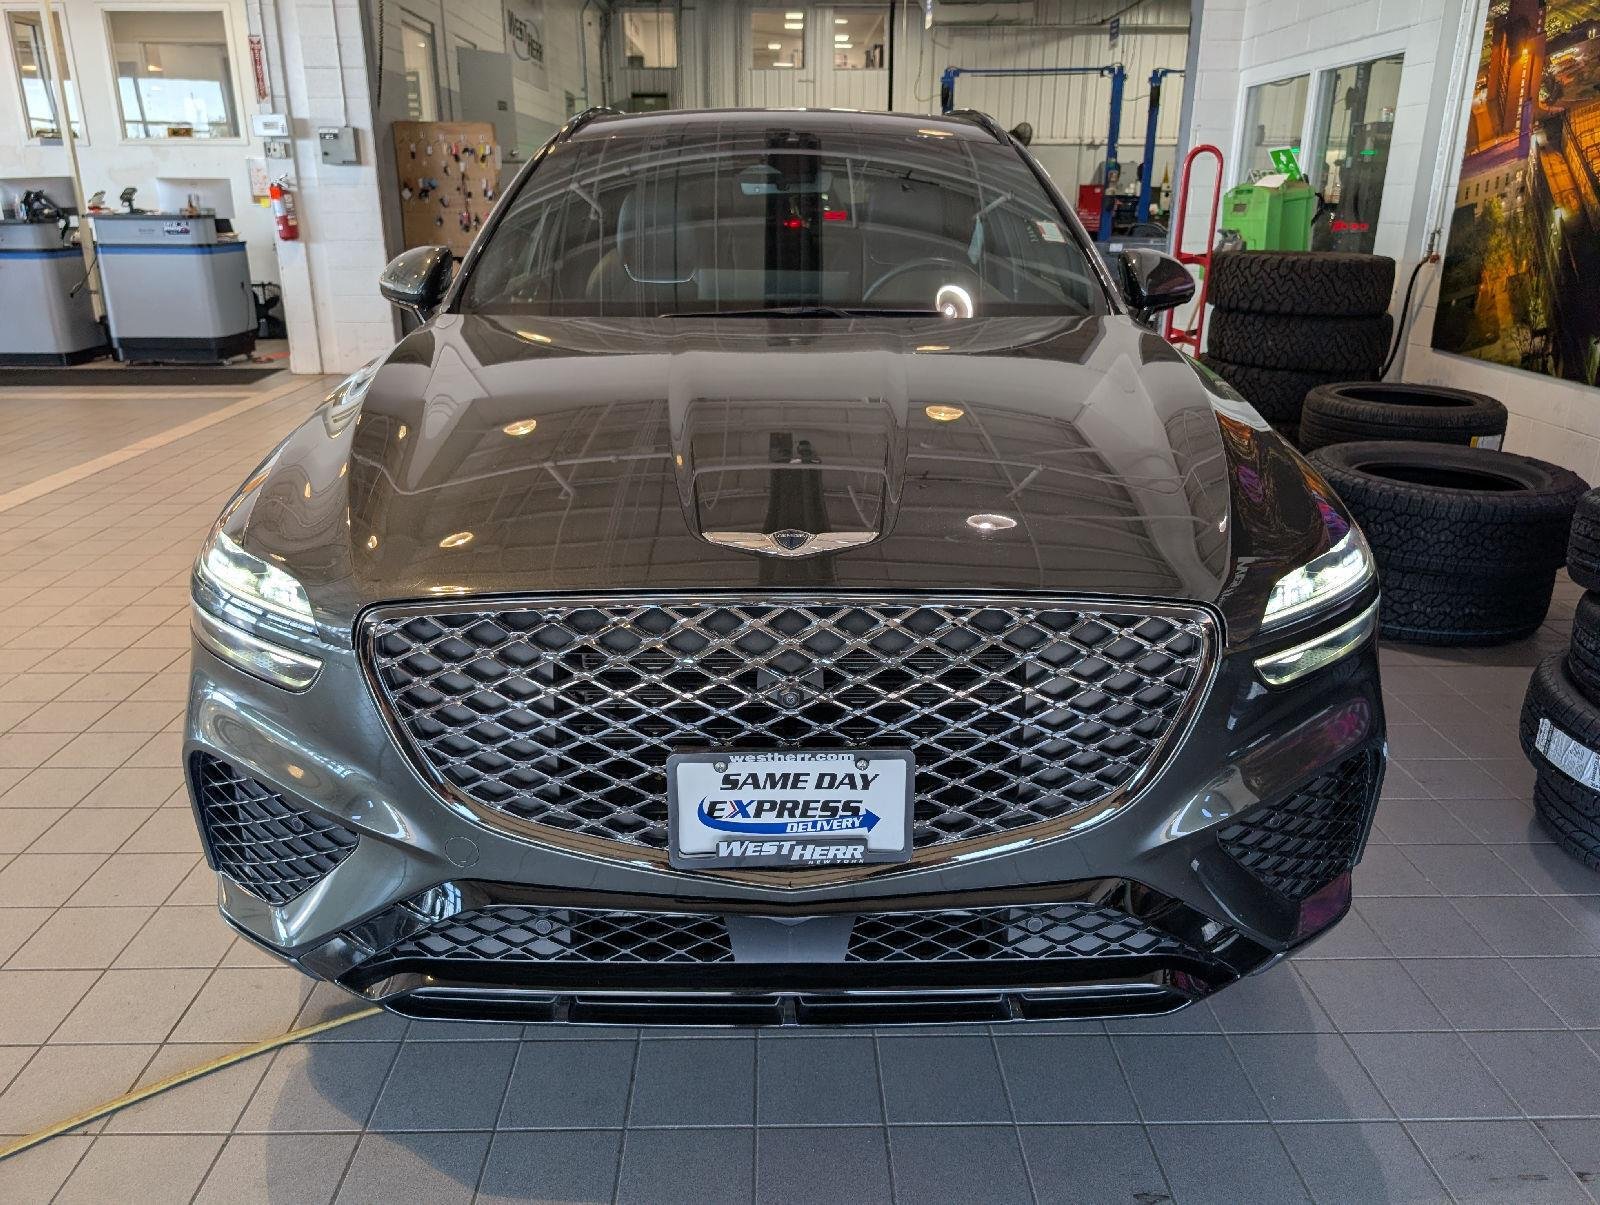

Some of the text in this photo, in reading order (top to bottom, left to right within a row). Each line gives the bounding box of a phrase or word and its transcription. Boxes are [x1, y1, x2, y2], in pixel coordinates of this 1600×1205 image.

[729, 752, 855, 763] westherr.com
[720, 772, 879, 791] SAME DAY
[706, 799, 864, 819] EXPRESS
[786, 816, 863, 834] DELIVERY
